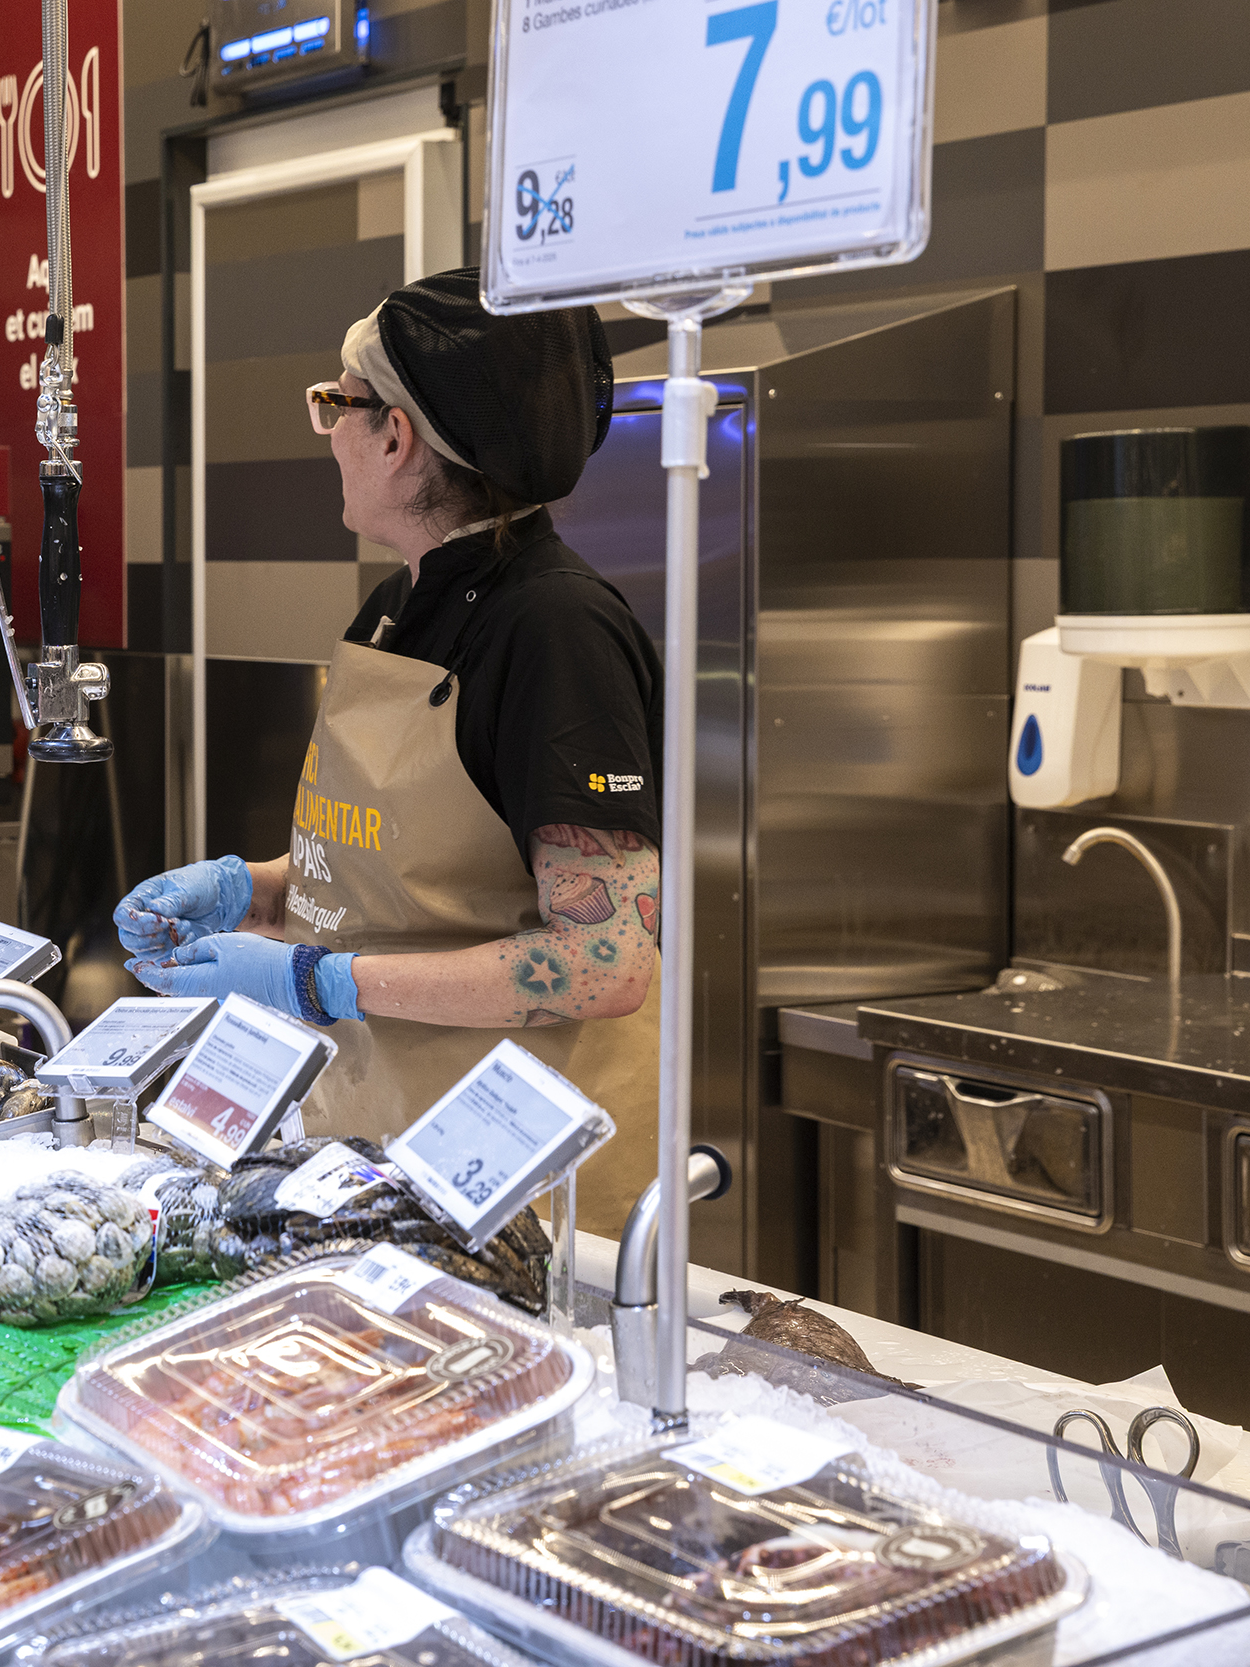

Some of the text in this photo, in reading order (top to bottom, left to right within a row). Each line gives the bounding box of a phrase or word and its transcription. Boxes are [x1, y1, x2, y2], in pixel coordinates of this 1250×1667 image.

[533, 6, 582, 31] Gambes
[5, 308, 25, 342] et
[19, 353, 38, 390] el
[168, 1096, 198, 1119] estalvi
